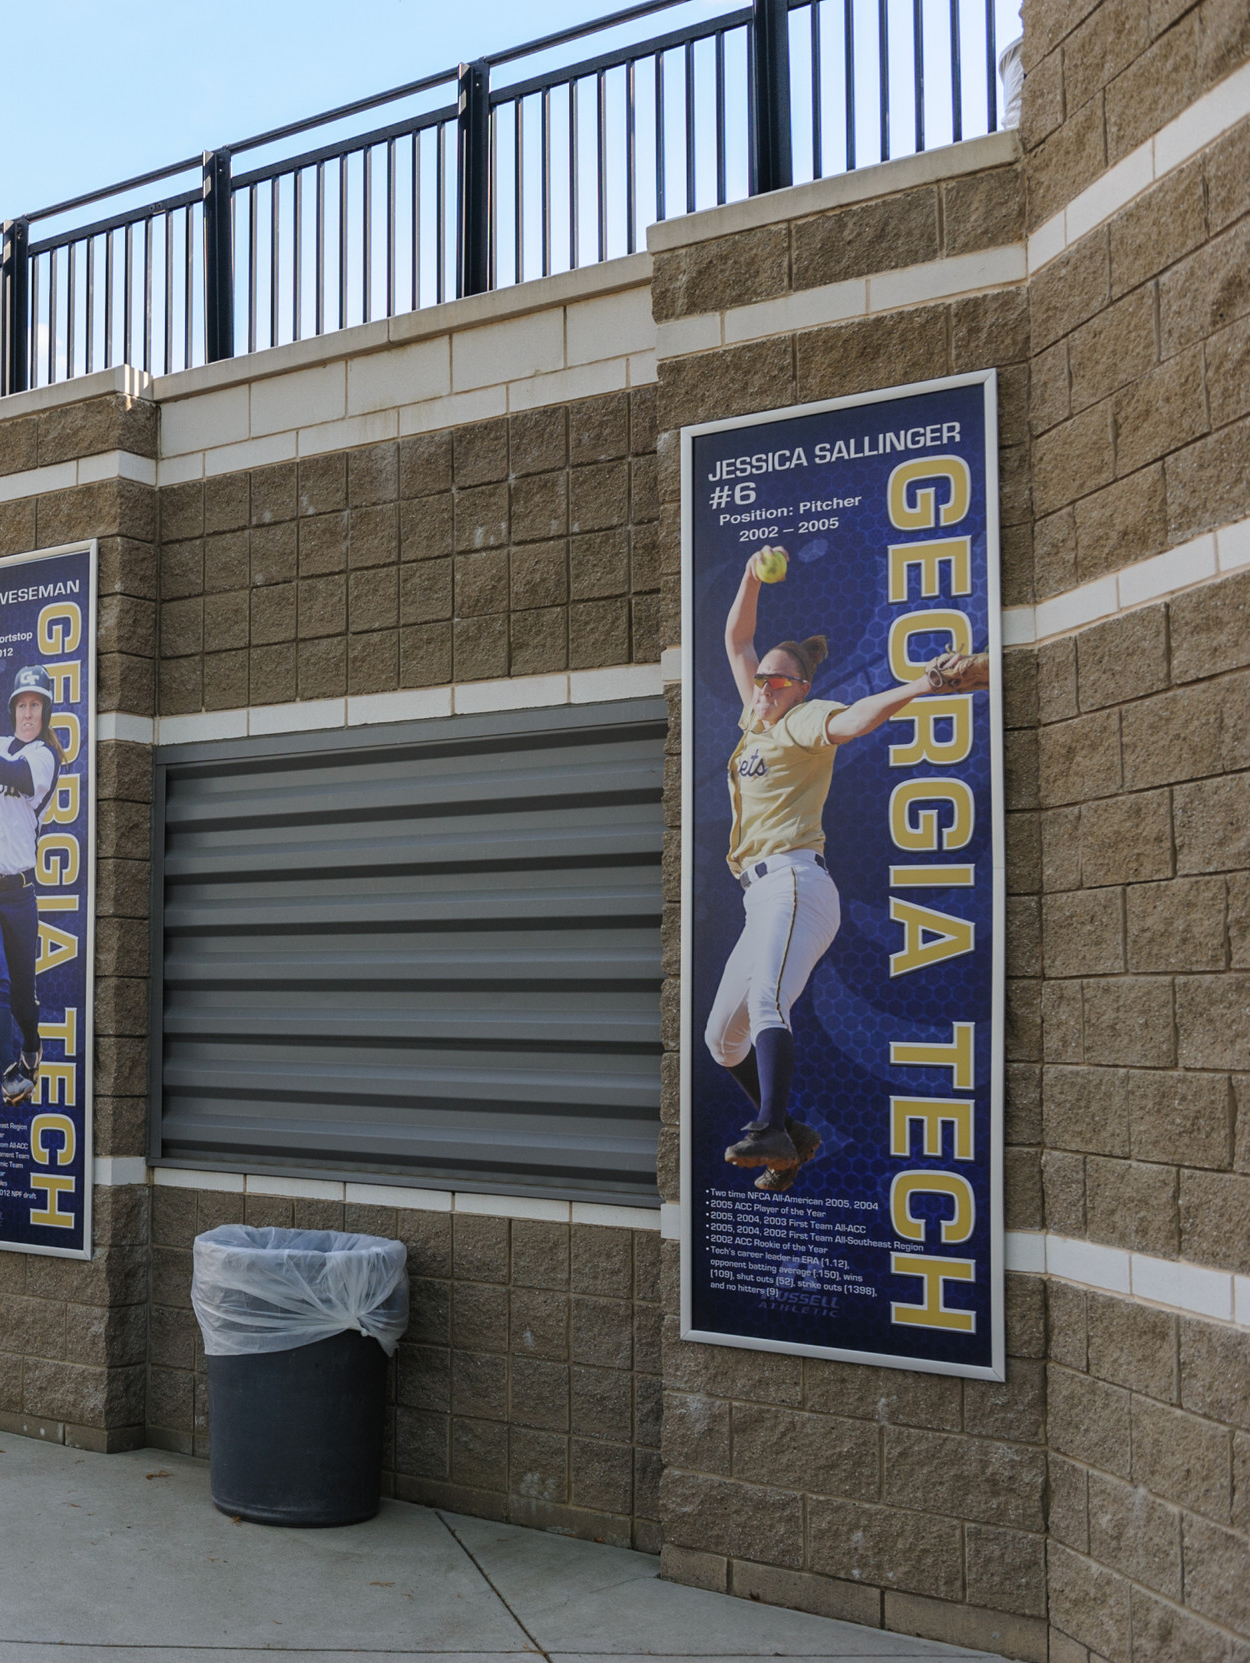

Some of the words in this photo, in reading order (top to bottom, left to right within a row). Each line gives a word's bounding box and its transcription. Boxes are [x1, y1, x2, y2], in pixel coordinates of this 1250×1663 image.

[708, 446, 808, 481] JESSICA
[814, 422, 961, 464] SALLINGER
[708, 482, 757, 510] #6
[719, 504, 794, 526] Position:
[799, 494, 862, 515] Pitcher
[739, 526, 779, 542] 2002
[798, 516, 840, 534] 2005
[887, 453, 976, 979] GEORGIA
[35, 601, 82, 976] GEORGIA
[30, 1007, 77, 1229] TECH
[889, 1021, 977, 1334] TECH
[710, 1188, 726, 1197] Two
[728, 1190, 746, 1199] time
[748, 1191, 770, 1201] NFCA
[772, 1193, 823, 1206] All-American
[825, 1198, 852, 1209] 2005,
[854, 1201, 878, 1210] 2004
[710, 1200, 733, 1209] 2005
[734, 1202, 752, 1211] ACC
[754, 1204, 779, 1214] Player
[780, 1206, 789, 1214] of
[790, 1207, 804, 1215] the
[806, 1208, 826, 1218] Year
[710, 1211, 735, 1222] 2005,
[736, 1214, 762, 1224] 2004,
[764, 1216, 787, 1225] 2003
[789, 1218, 808, 1228] First
[810, 1220, 833, 1230] Team
[834, 1223, 866, 1234] All-ACC
[710, 1223, 735, 1233] 2005,
[736, 1225, 762, 1236] 2004,
[764, 1228, 787, 1238] 2002
[789, 1230, 808, 1240] First
[810, 1232, 833, 1242] Team
[835, 1235, 892, 1249] All-Southeast
[894, 1241, 924, 1252] Region
[710, 1234, 733, 1244] 2002
[734, 1237, 752, 1246] ACC
[754, 1239, 780, 1249] Rookie
[782, 1242, 790, 1250] of
[792, 1243, 806, 1252] the
[808, 1244, 828, 1254] Year
[710, 1245, 735, 1256] Tech's
[737, 1250, 764, 1258] career
[765, 1252, 791, 1262] leader
[801, 1256, 819, 1265] ERA
[710, 1259, 747, 1269] opponent
[748, 1262, 777, 1274] batting
[778, 1266, 811, 1277] average
[843, 1273, 863, 1282] wins
[736, 1273, 754, 1281] shut
[756, 1276, 774, 1284] outs
[798, 1280, 822, 1290] strike
[823, 1284, 842, 1292] outs
[738, 1284, 765, 1294] hitters
